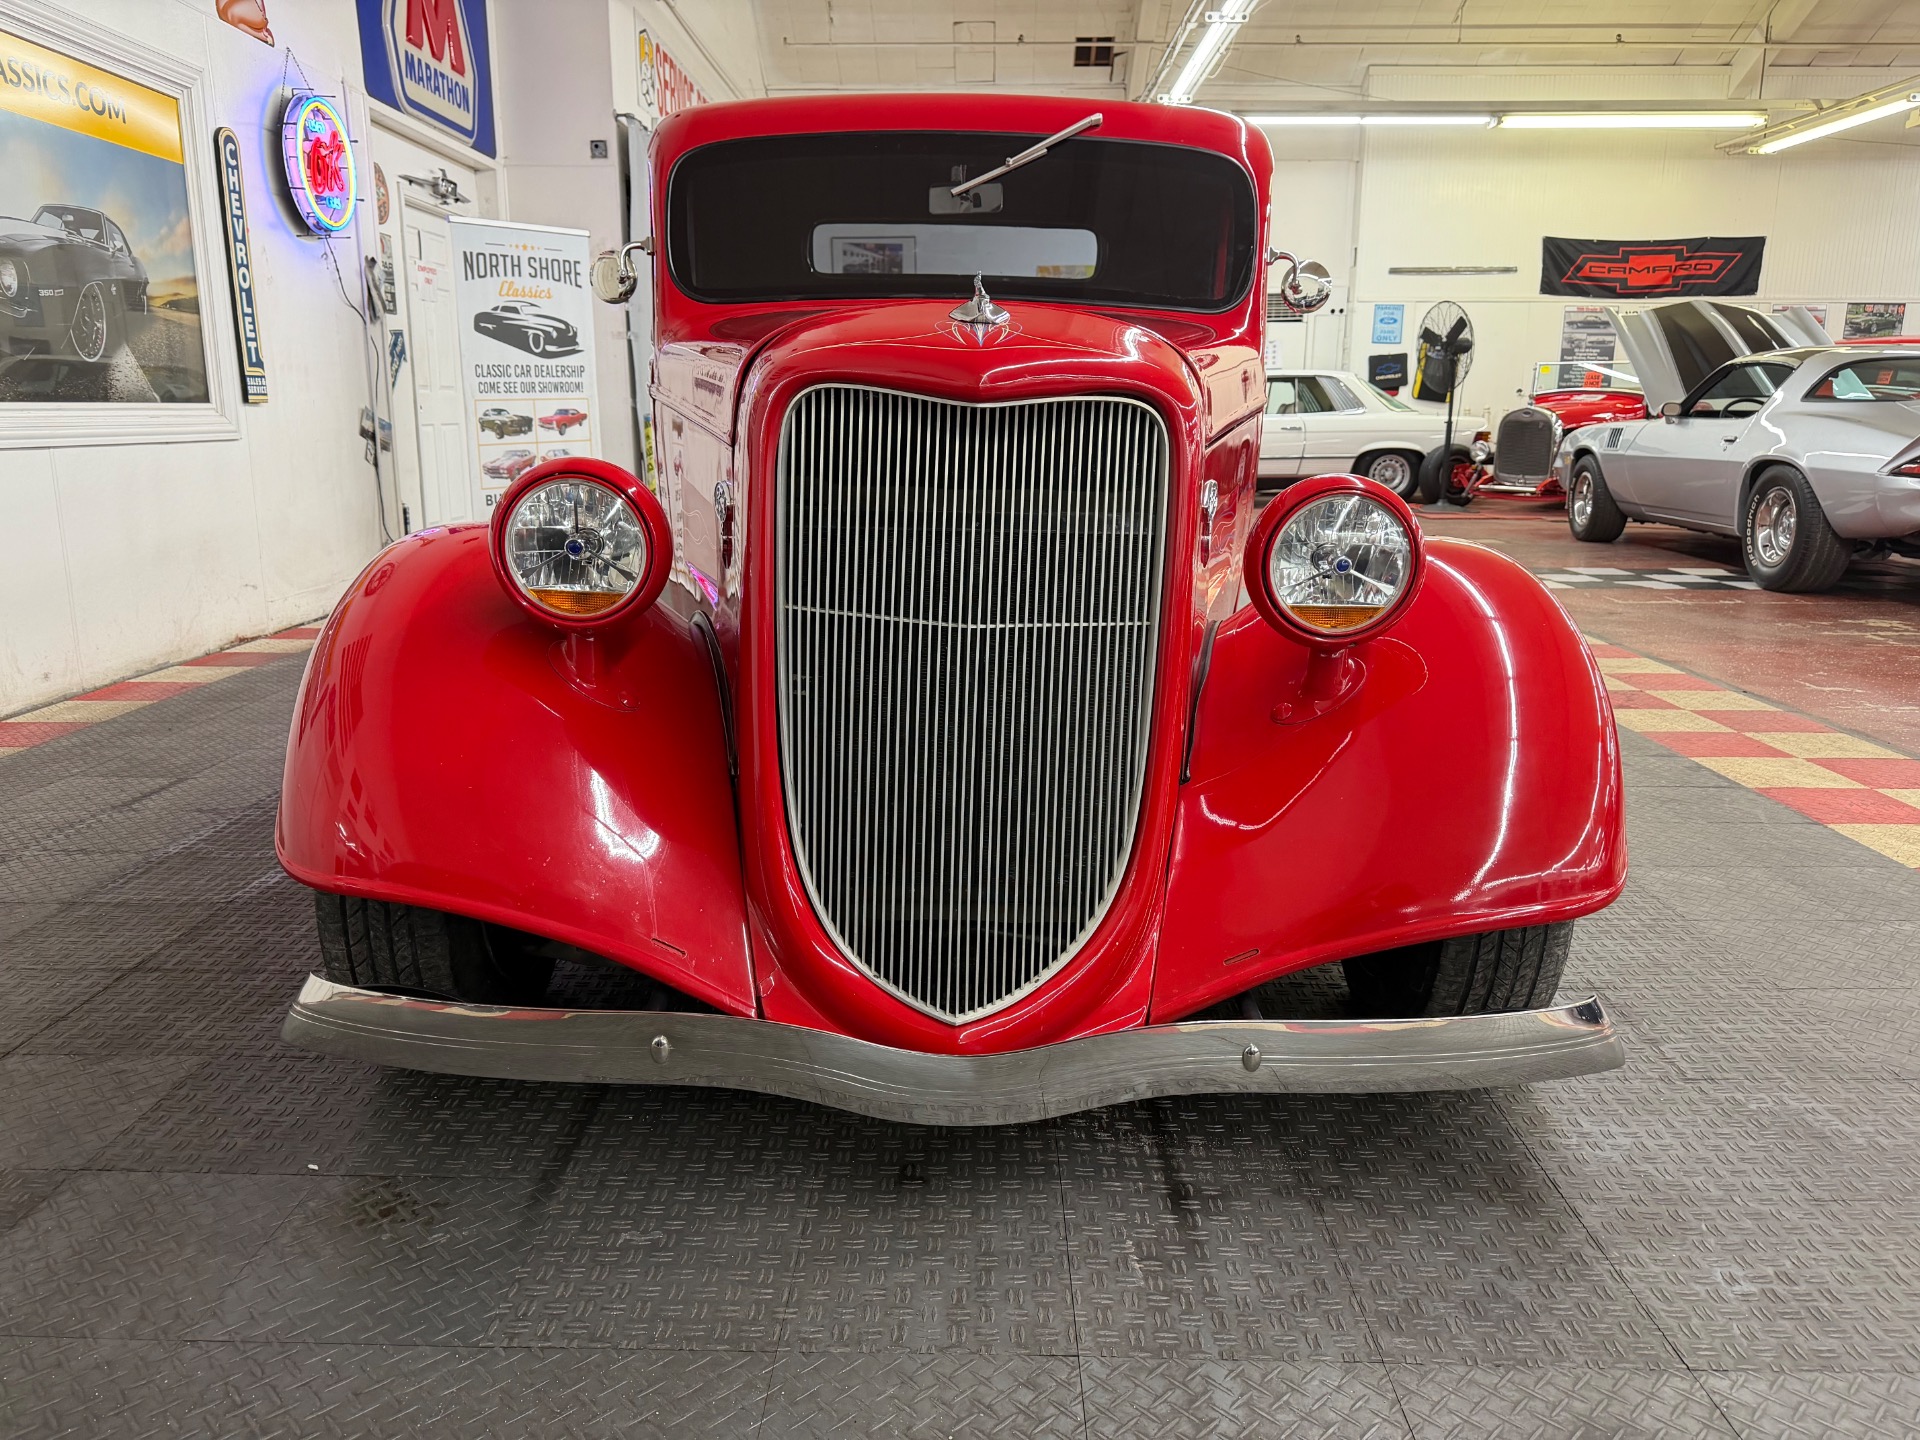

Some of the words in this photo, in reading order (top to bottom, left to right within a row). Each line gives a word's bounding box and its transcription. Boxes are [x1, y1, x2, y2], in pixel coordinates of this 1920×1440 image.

[405, 49, 470, 114] MARATHON
[225, 142, 257, 363] CHEVROLET
[463, 250, 522, 282] NORTH
[528, 256, 583, 289] SHORE
[1588, 262, 1713, 275] CAMARO
[38, 289, 54, 297] 350
[498, 280, 553, 300] Classics
[474, 363, 512, 379] CLASSIC
[514, 364, 532, 378] CAR
[534, 364, 585, 379] DEALERSHIP
[247, 385, 267, 394] SERVICE
[478, 381, 501, 394] COME
[503, 381, 518, 394] SEE
[520, 381, 537, 394] OUR
[538, 381, 584, 394] SHOWROOM!
[1746, 494, 1760, 567] BFGoodrich
